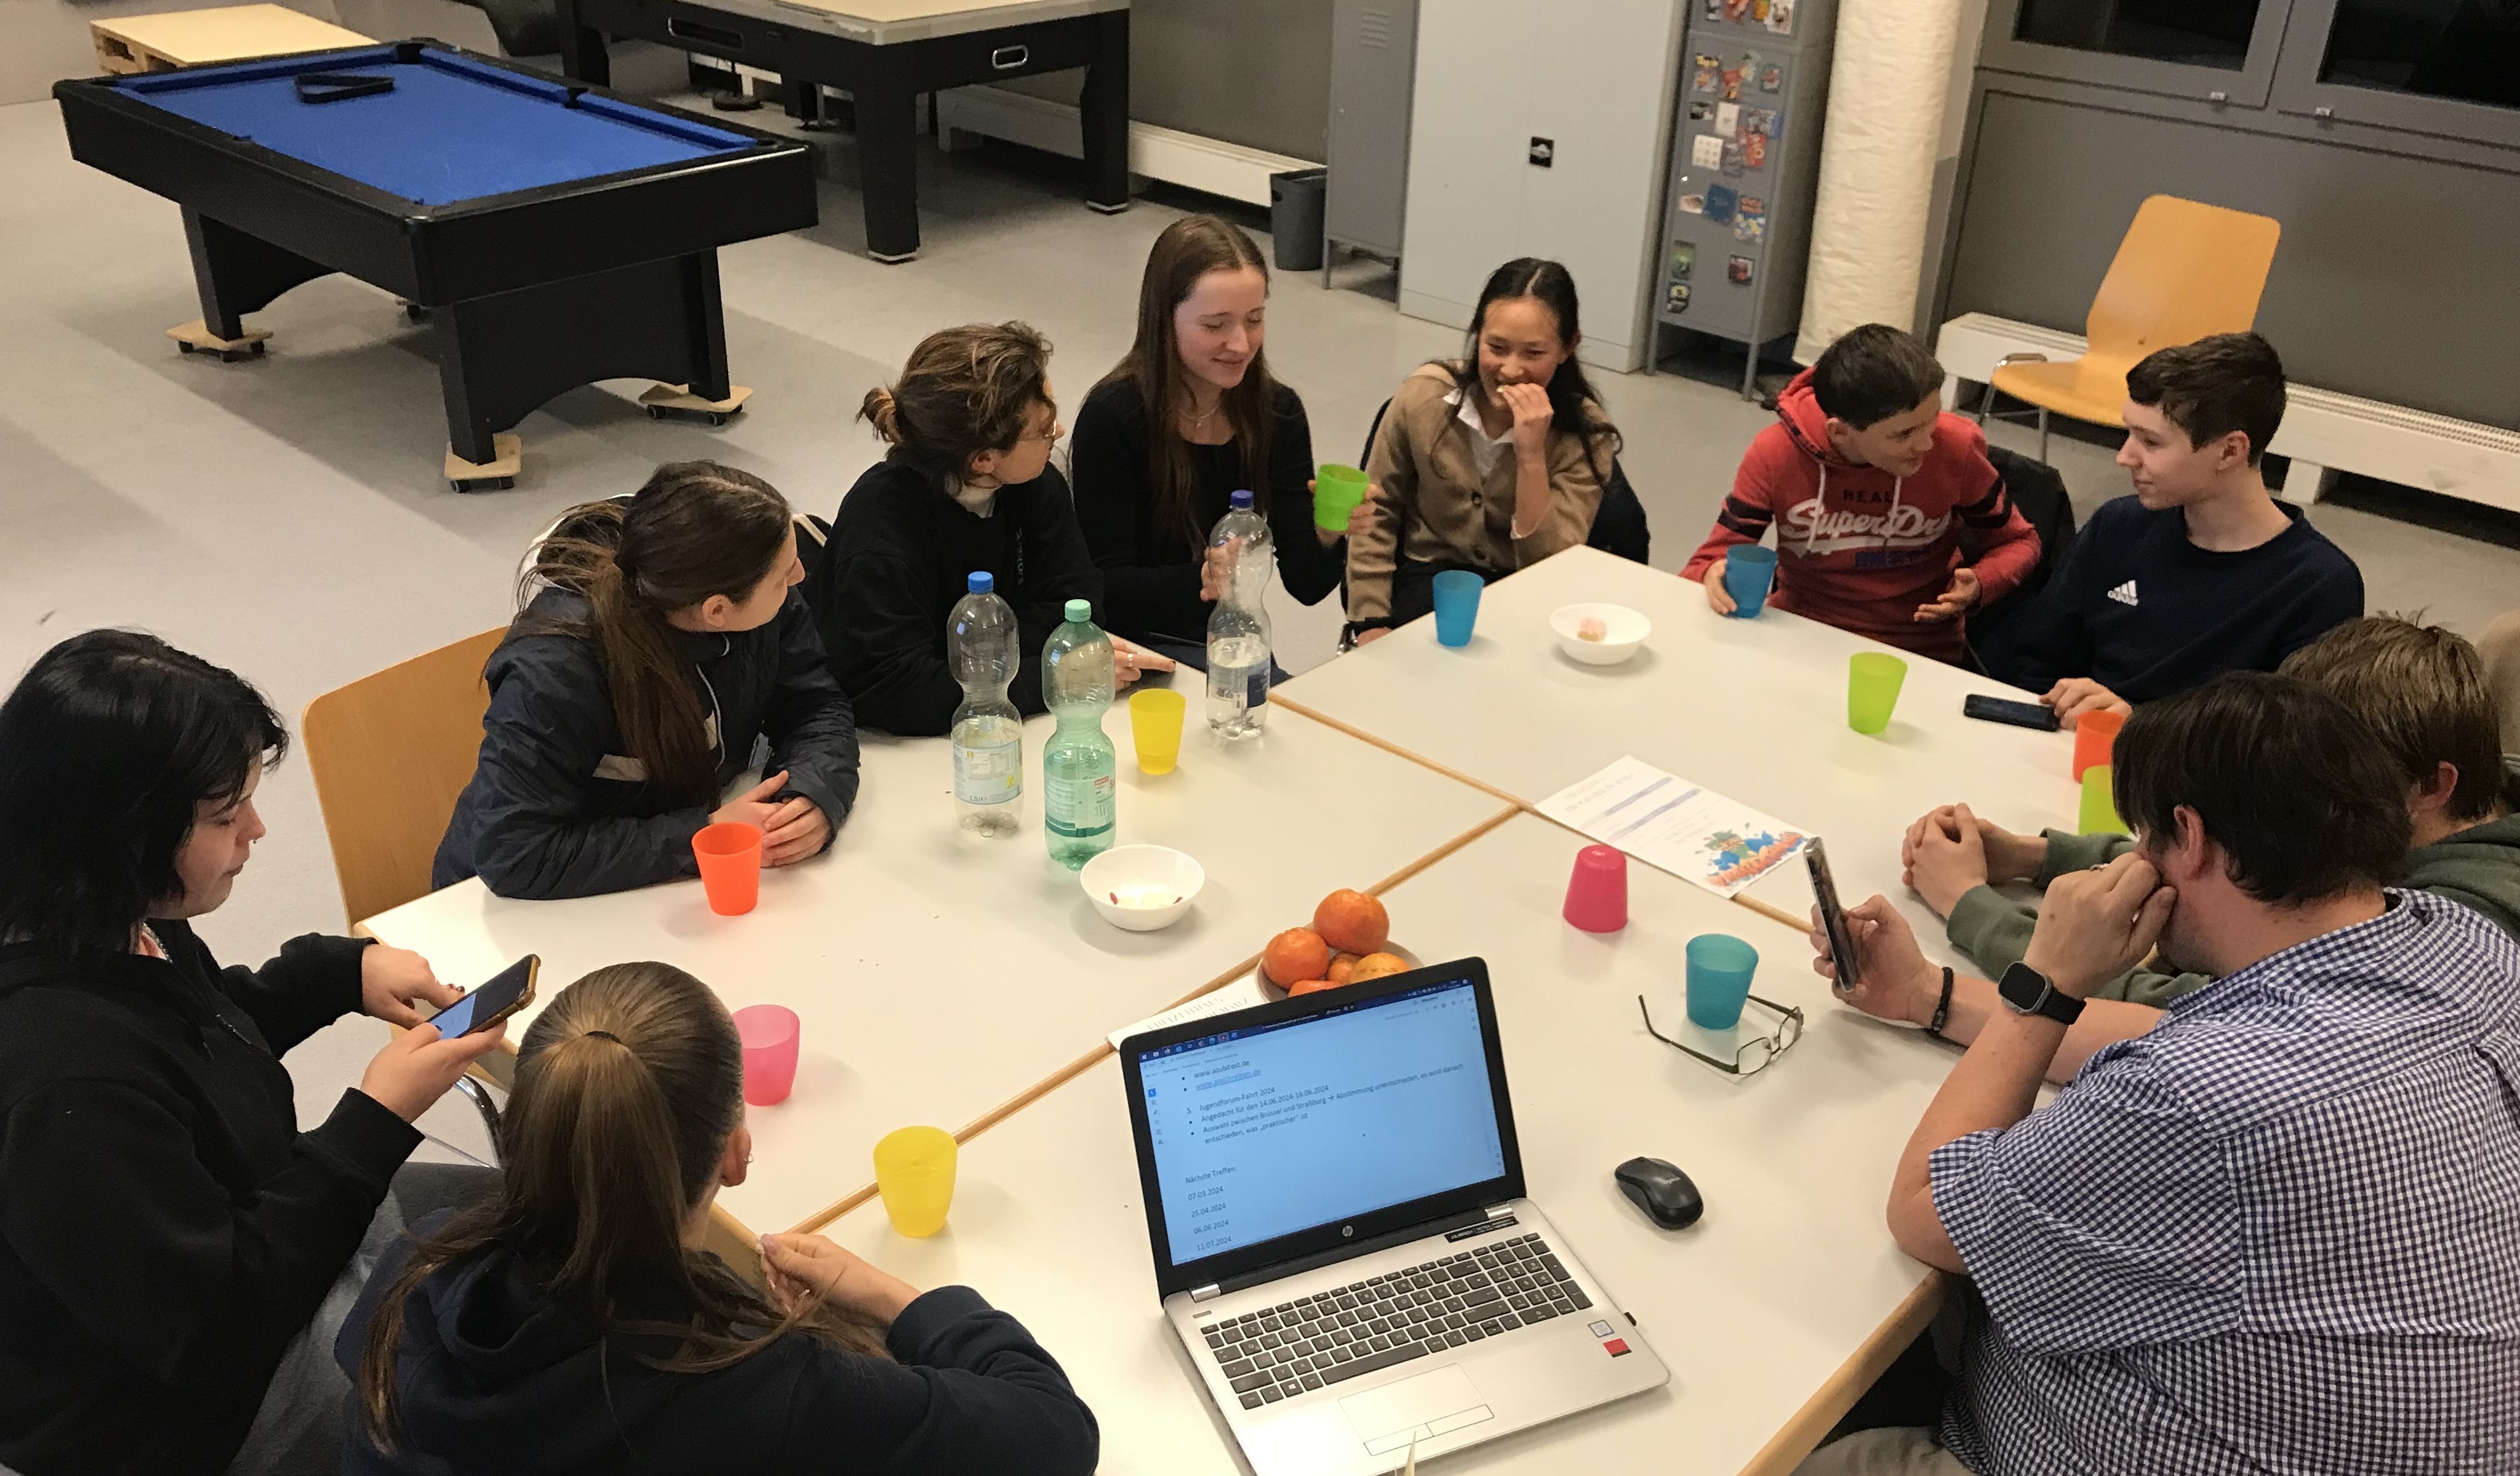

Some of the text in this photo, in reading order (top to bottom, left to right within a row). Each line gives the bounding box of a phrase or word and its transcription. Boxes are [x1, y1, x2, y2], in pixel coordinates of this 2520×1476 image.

[1194, 1059, 1250, 1078] www.azubitest.de
[1199, 1091, 1258, 1111] Jugendforum-Fahrt
[1260, 1087, 1275, 1096] 2024
[1201, 1110, 1234, 1123] Angedacht
[1246, 1103, 1258, 1111] den
[1203, 1120, 1230, 1133] Auswahl
[1230, 1114, 1259, 1127] zwischen
[1260, 1108, 1282, 1119] Brüssel
[1283, 1104, 1296, 1113] und
[1297, 1097, 1326, 1110] Straßburg
[1204, 1130, 1245, 1144] entschieden,
[1185, 1172, 1211, 1184] Nächste
[1188, 1186, 1223, 1200] 07.03.2024
[1191, 1203, 1226, 1218] 25.04.2024
[1194, 1219, 1229, 1234] 06.06.2024
[1197, 1236, 1232, 1251] 11.07.2024
